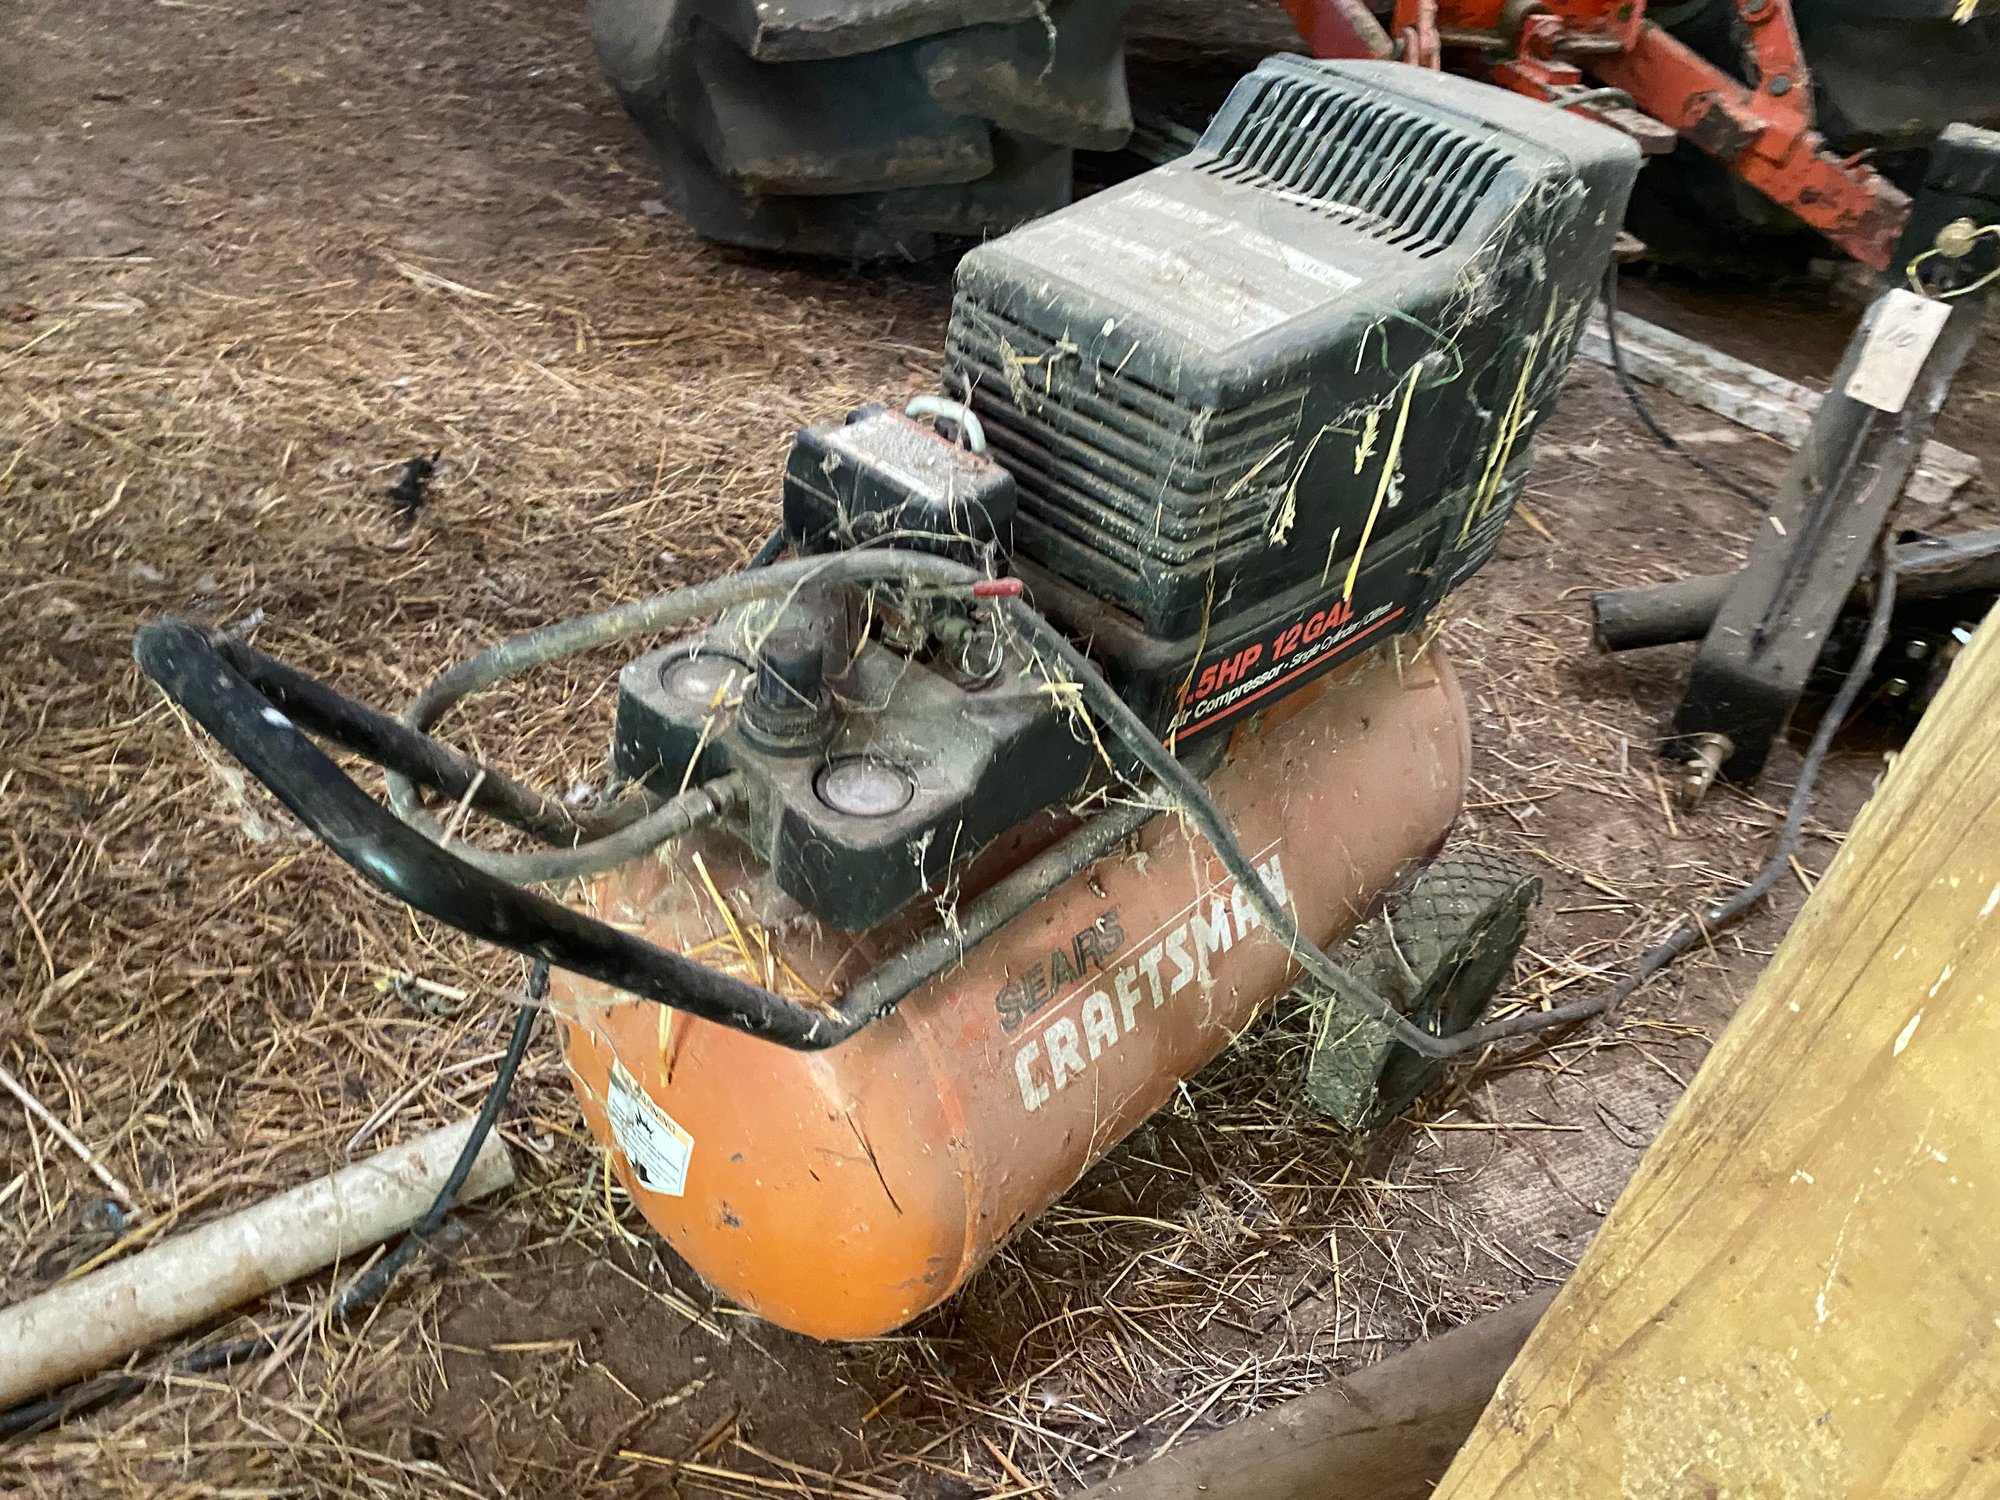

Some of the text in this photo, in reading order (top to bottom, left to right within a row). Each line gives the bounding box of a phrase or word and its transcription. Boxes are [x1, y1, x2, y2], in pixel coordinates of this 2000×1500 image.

[1176, 643, 1263, 707] .5HP
[1272, 623, 1303, 662] 12
[1302, 596, 1355, 645] GAL
[1194, 664, 1285, 719] Compressor
[995, 910, 1125, 1031] SEARS
[1014, 853, 1287, 1112] CRAFTSMAN
